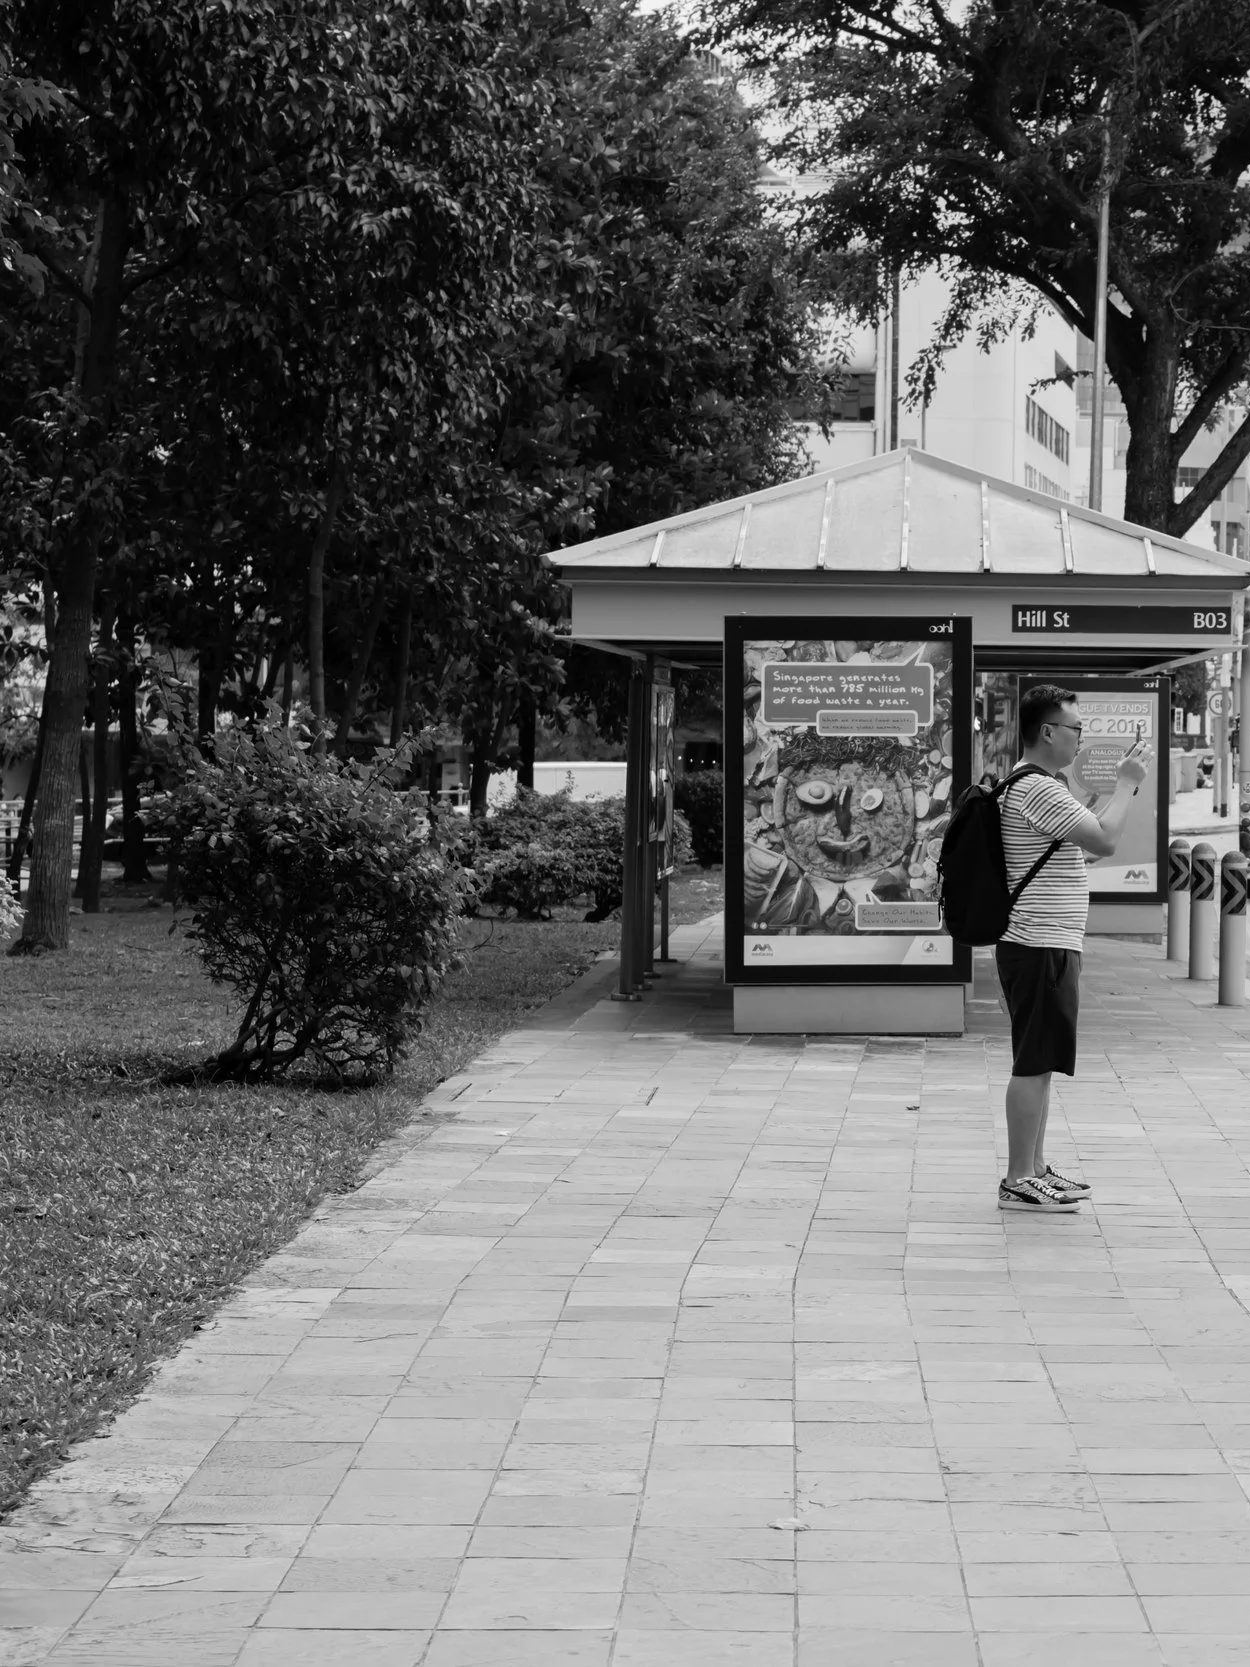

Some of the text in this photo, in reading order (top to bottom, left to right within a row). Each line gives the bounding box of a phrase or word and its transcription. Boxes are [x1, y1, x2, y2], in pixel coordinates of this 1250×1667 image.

[1017, 610, 1070, 628] Hill St
[1193, 612, 1227, 629] B03
[772, 670, 901, 684] Singapore generates
[772, 686, 803, 694] more
[809, 684, 836, 694] than
[840, 683, 864, 693] 785
[869, 685, 906, 694] million
[772, 697, 786, 705] of
[791, 697, 820, 705] food
[826, 697, 860, 705] waste
[879, 697, 910, 707] year.
[1079, 703, 1149, 713] GUE TV ENDS
[1081, 718, 1102, 733] EC
